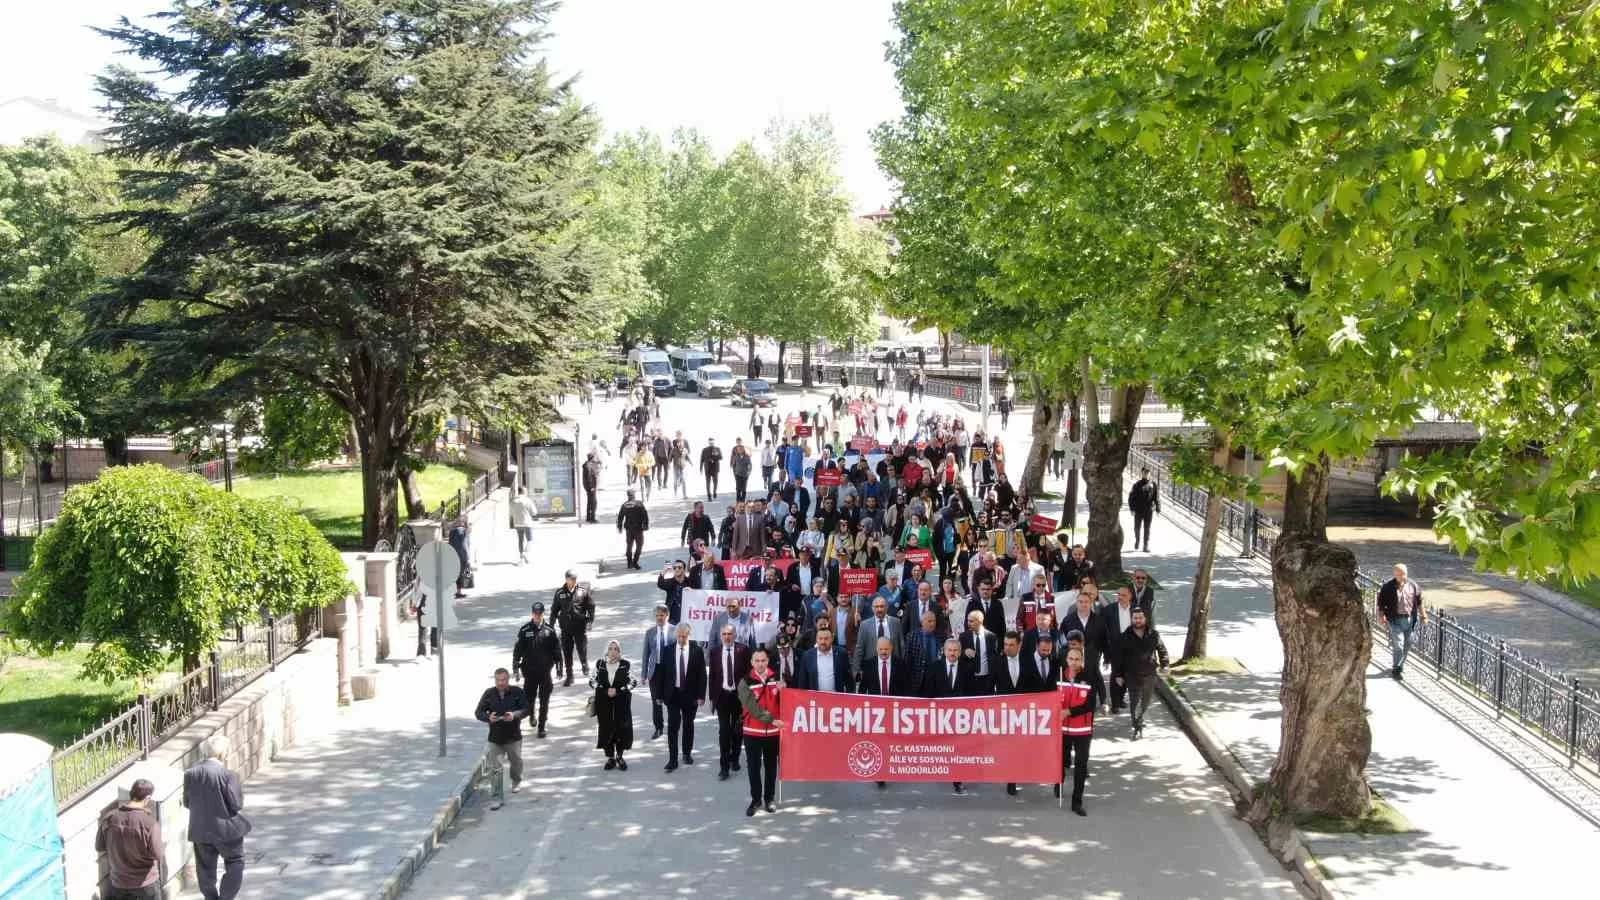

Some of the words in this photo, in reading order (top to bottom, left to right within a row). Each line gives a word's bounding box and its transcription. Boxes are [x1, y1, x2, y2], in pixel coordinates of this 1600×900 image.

[792, 700, 886, 734] AİLEMİZ
[893, 701, 1051, 735] İSTİKBALİMİZ
[889, 745, 903, 753] T.C.
[904, 745, 955, 753] KASTAMONU
[889, 755, 907, 764] AİLE
[908, 756, 919, 764] VE
[920, 756, 949, 764] SOSYAL
[950, 755, 994, 764] HİZMETLER
[889, 766, 897, 774] İL
[897, 765, 949, 775] MÜDÜRLÜĞÜ
